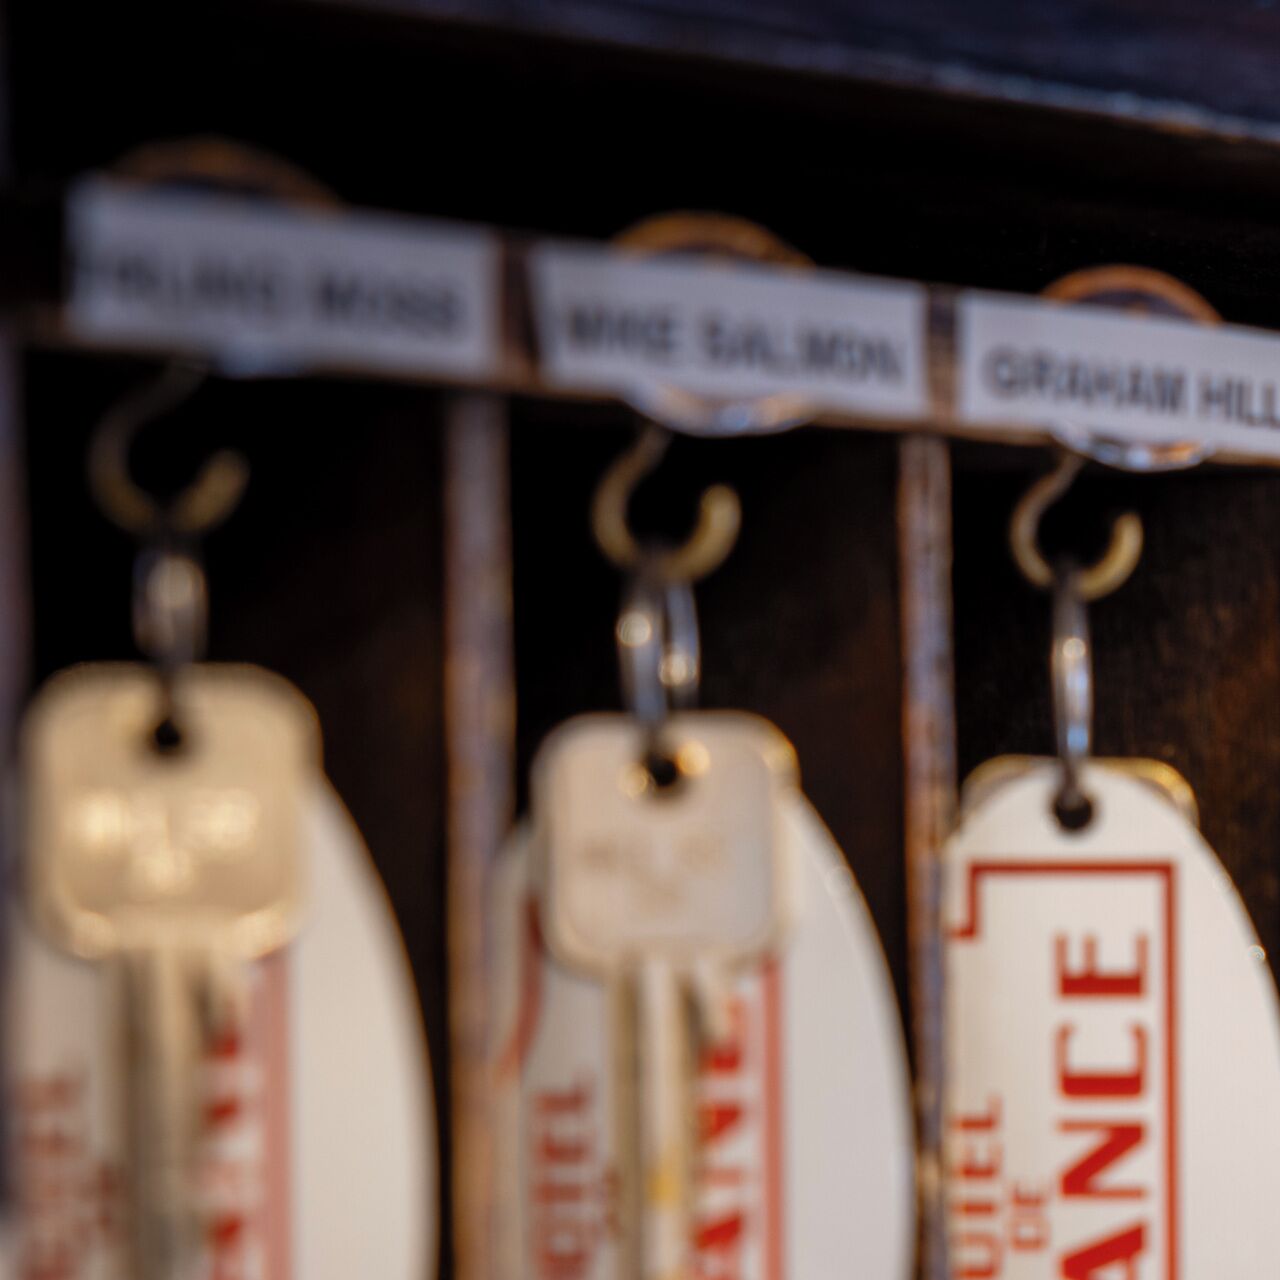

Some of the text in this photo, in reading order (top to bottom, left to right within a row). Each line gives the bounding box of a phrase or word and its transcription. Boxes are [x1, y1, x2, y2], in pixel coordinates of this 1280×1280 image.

[703, 306, 903, 382] SALMON
[985, 344, 1190, 414] GRAHAM
[1009, 1177, 1050, 1252] DE
